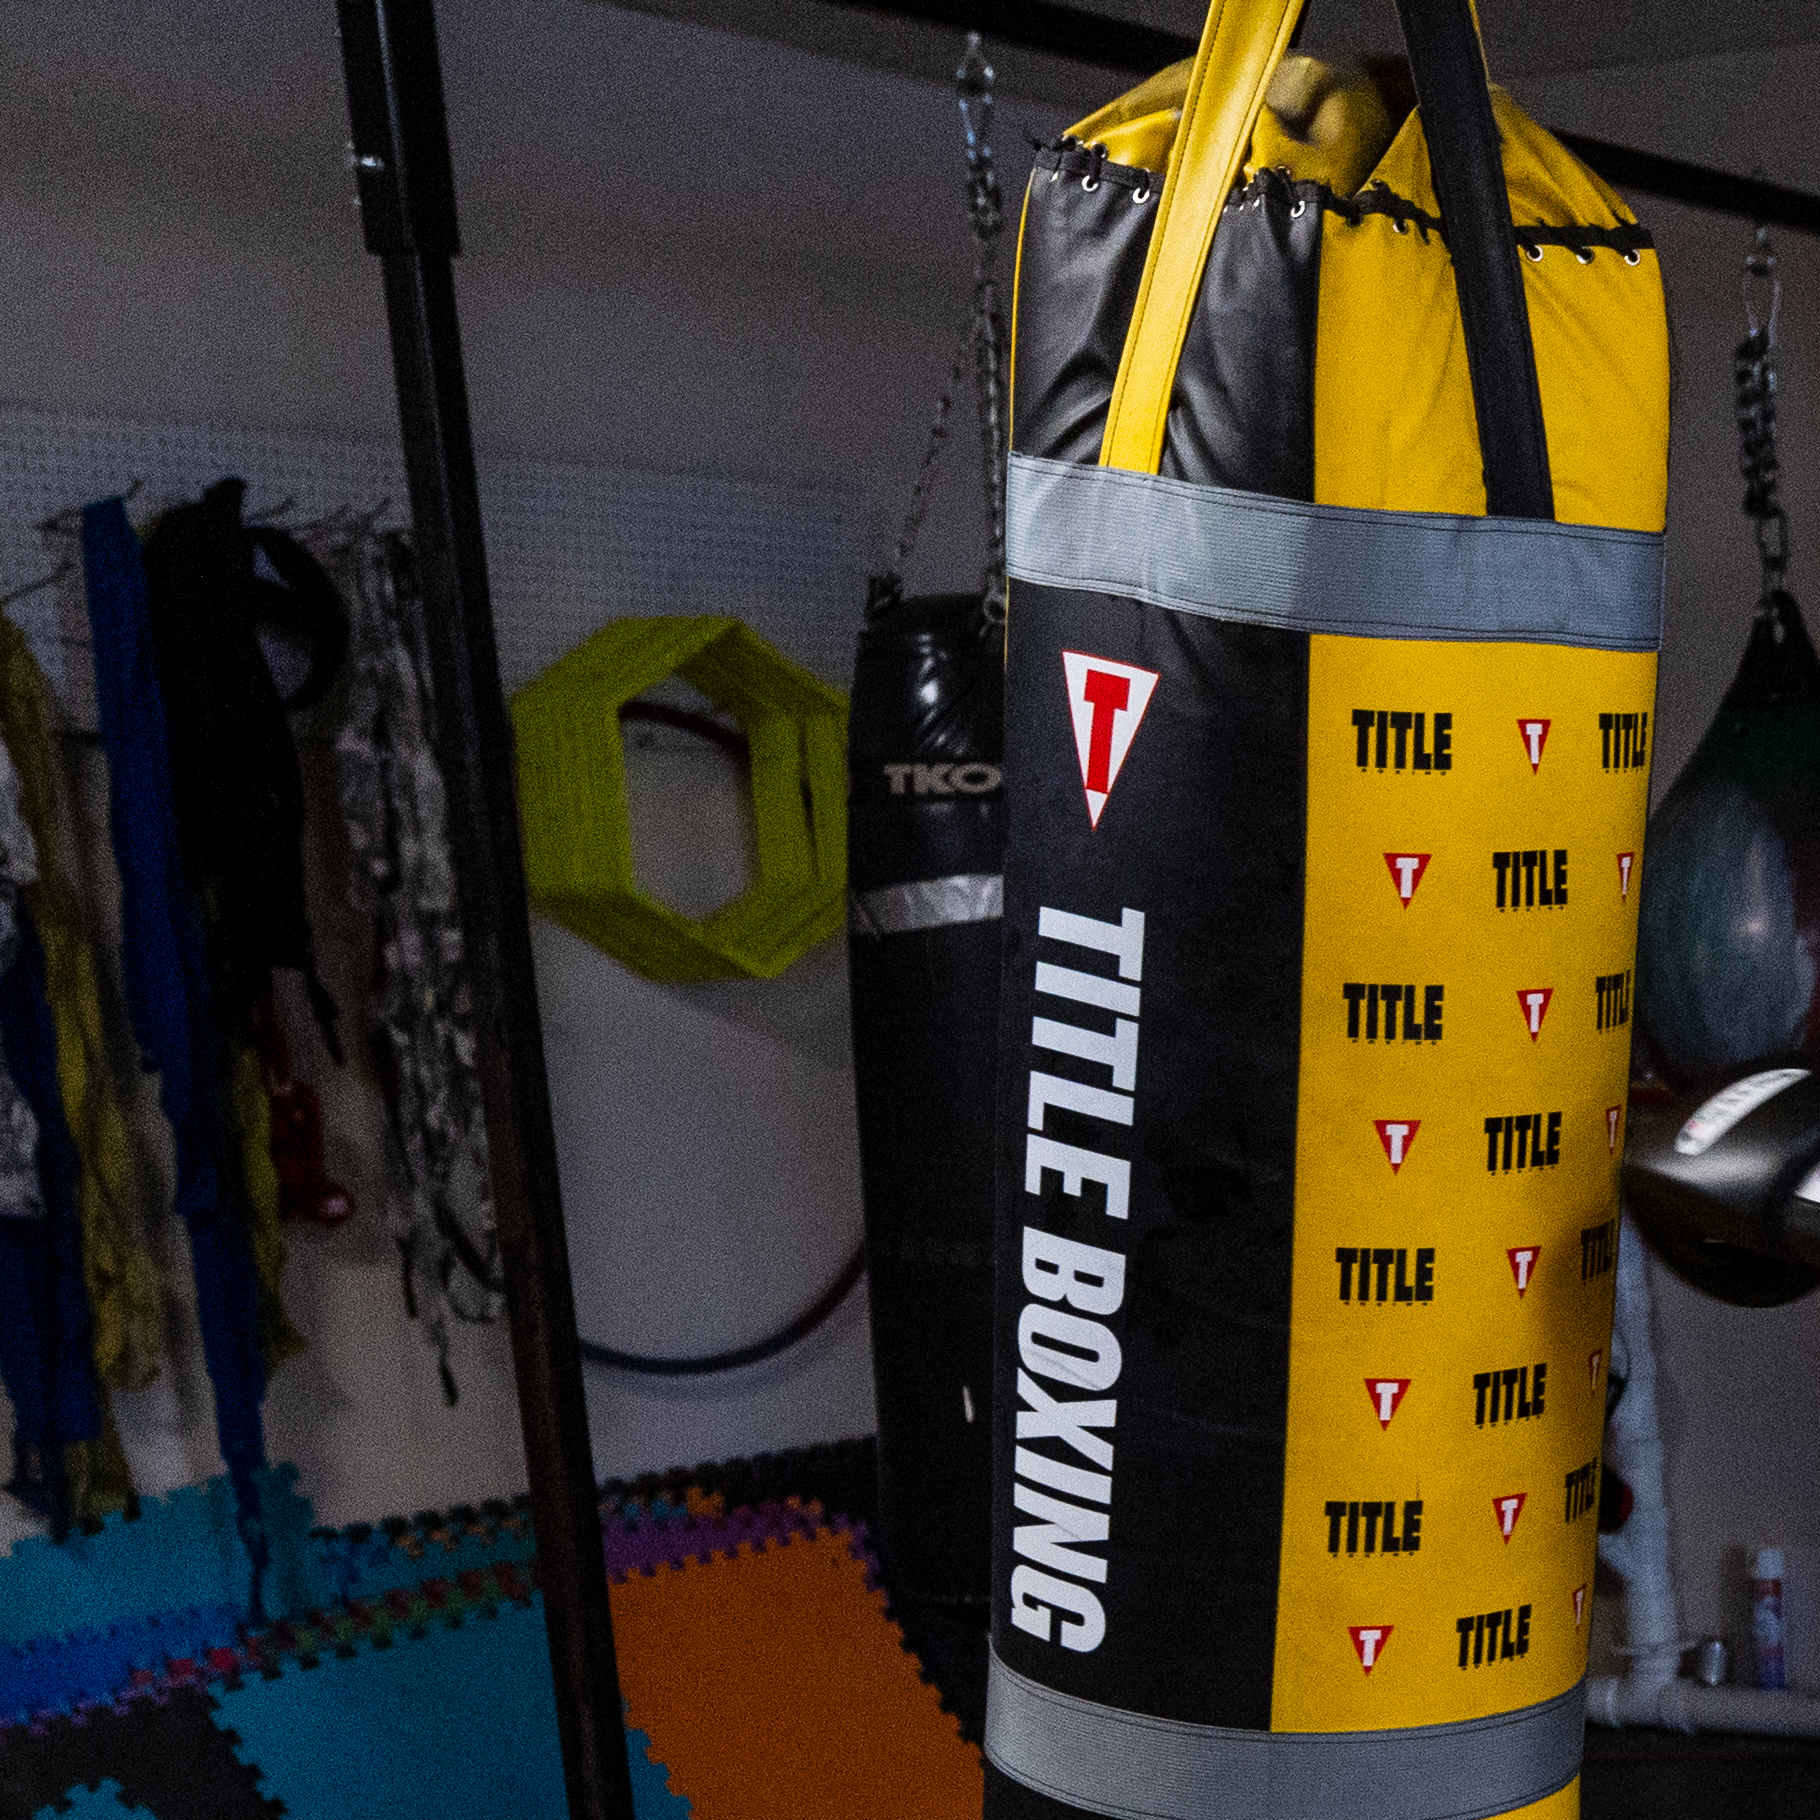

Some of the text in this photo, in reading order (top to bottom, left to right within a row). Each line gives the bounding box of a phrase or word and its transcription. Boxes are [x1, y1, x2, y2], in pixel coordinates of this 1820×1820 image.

[1084, 669, 1130, 795] T
[1352, 710, 1451, 770] TITLE
[885, 763, 1001, 794] TKO
[1493, 850, 1567, 908] TITLE
[1343, 983, 1443, 1040] TITLE
[1596, 969, 1630, 1030] TITL
[1485, 1112, 1562, 1171] TITLE
[1011, 907, 1144, 1652] TITLE BOXING
[1336, 1248, 1434, 1301] TITLE
[1474, 1364, 1547, 1426] TITLE
[1325, 1501, 1422, 1553] TITLE
[1457, 1605, 1531, 1667] TITLE
